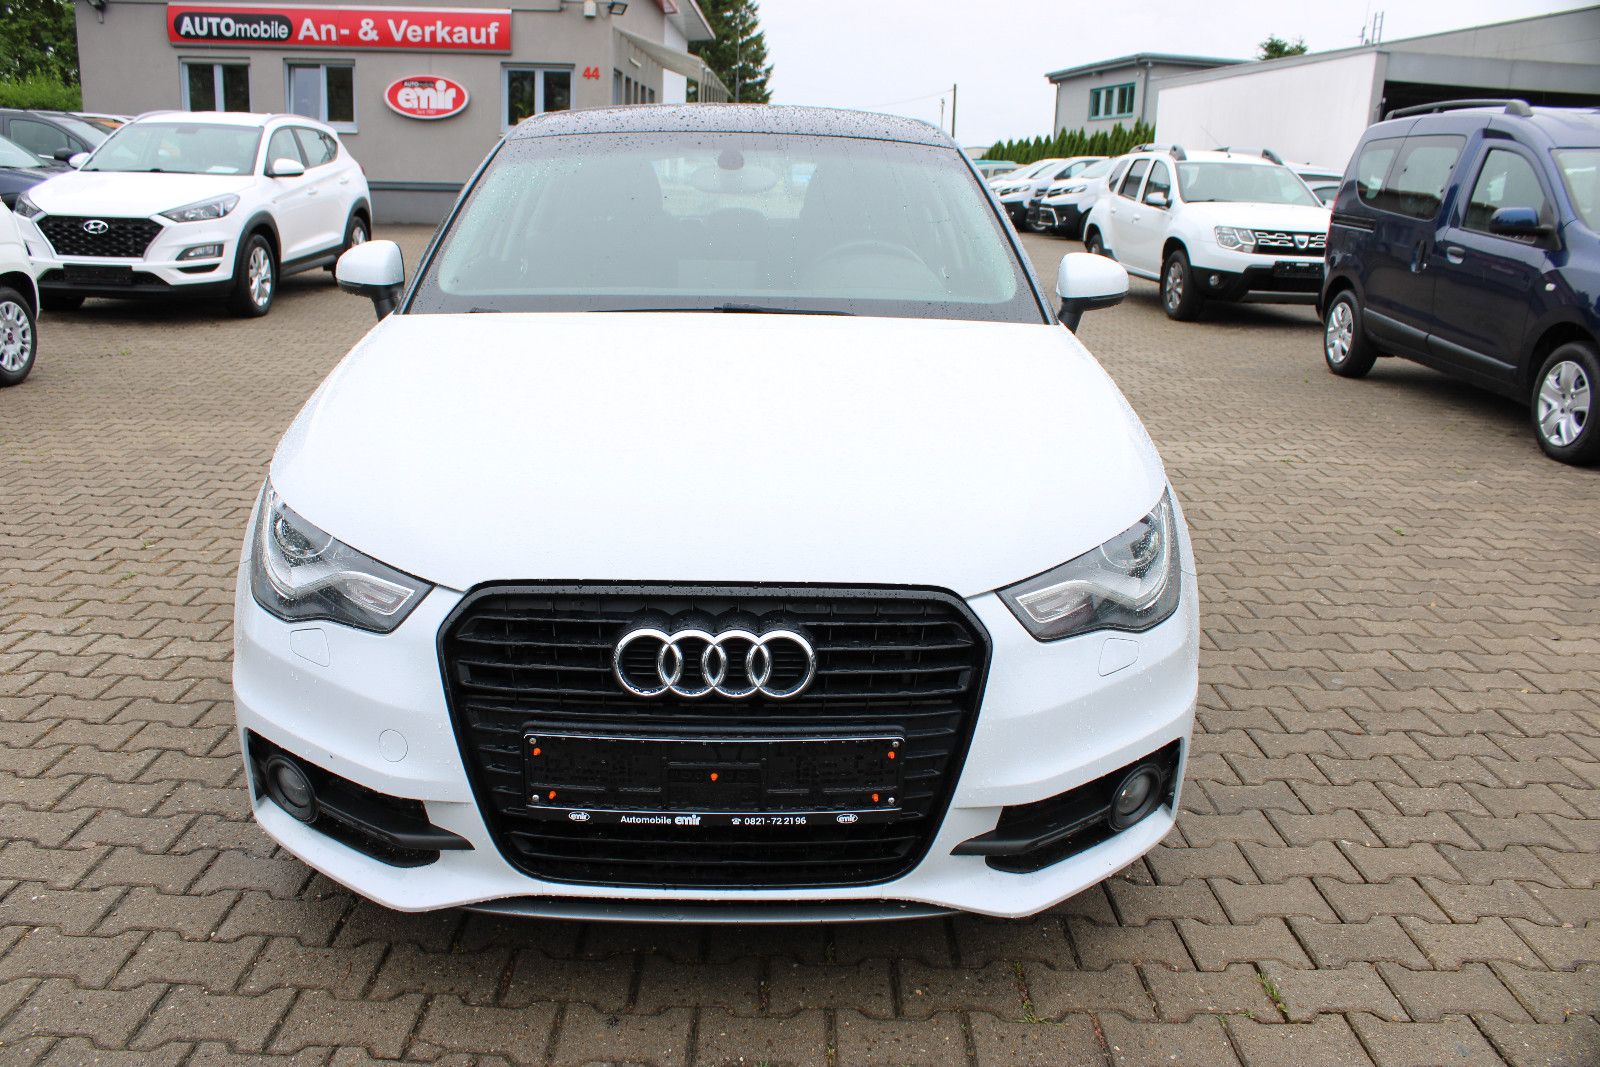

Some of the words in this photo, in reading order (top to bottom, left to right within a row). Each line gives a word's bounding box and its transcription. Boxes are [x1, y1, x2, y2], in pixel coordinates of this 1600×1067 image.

[180, 16, 289, 39] AUTOmobile
[298, 17, 350, 41] An-
[358, 18, 379, 41] &
[388, 19, 500, 44] Verkauf
[582, 64, 600, 80] 44
[397, 80, 457, 109] emir
[620, 815, 672, 825] Automobile
[674, 814, 701, 826] emir
